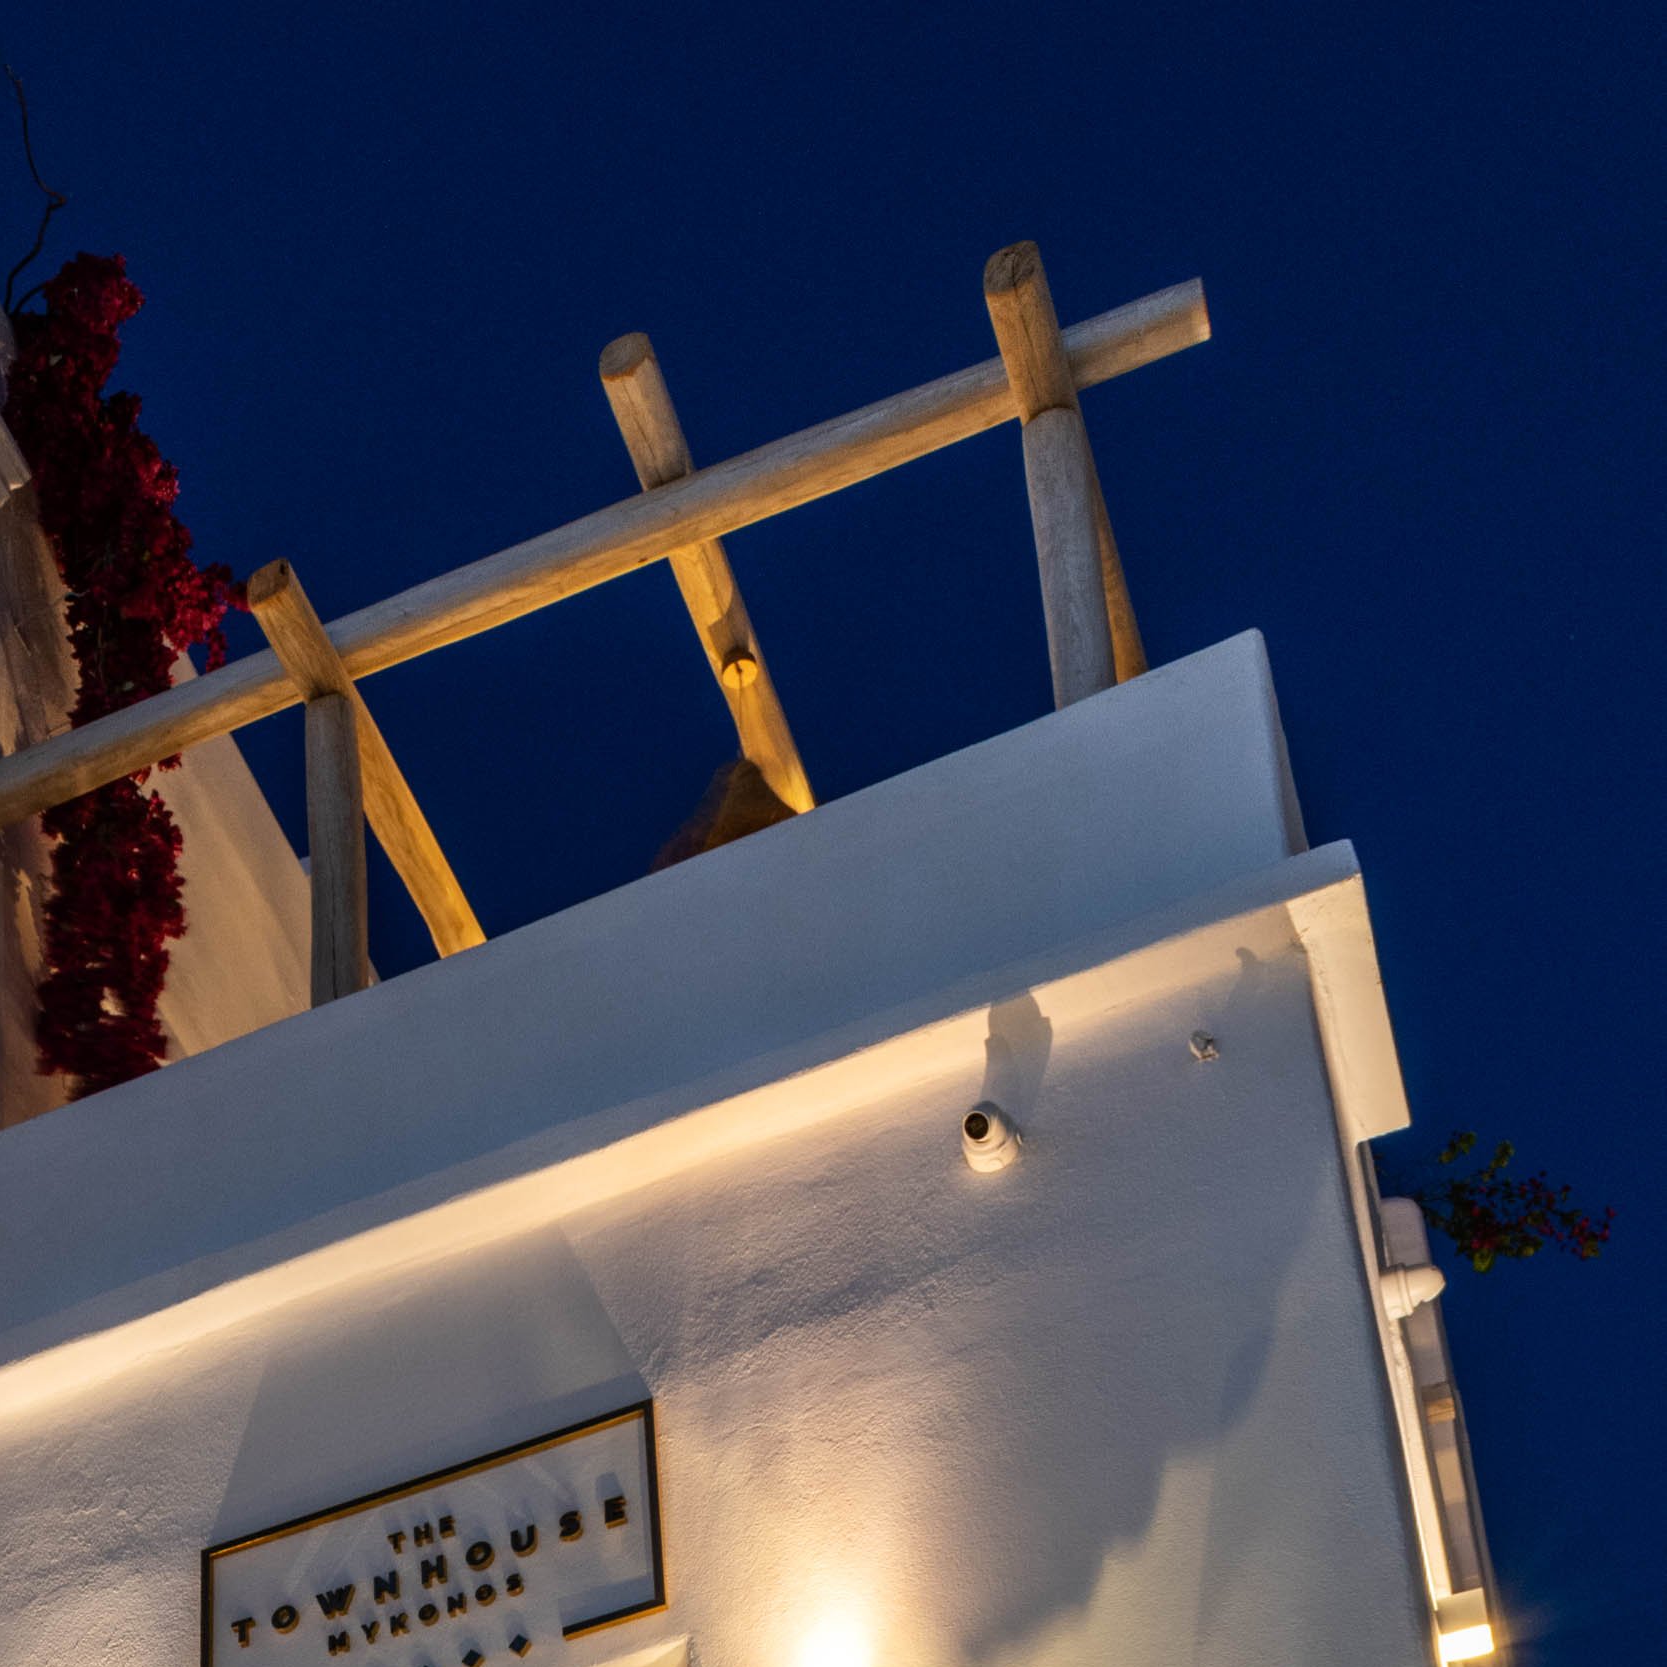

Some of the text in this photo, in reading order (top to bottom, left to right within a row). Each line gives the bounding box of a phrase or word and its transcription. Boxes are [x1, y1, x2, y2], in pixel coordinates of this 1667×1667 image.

[231, 1495, 628, 1647] TOWNHOUSE
[387, 1515, 456, 1554] THE
[328, 1573, 525, 1656] MYKONOS
